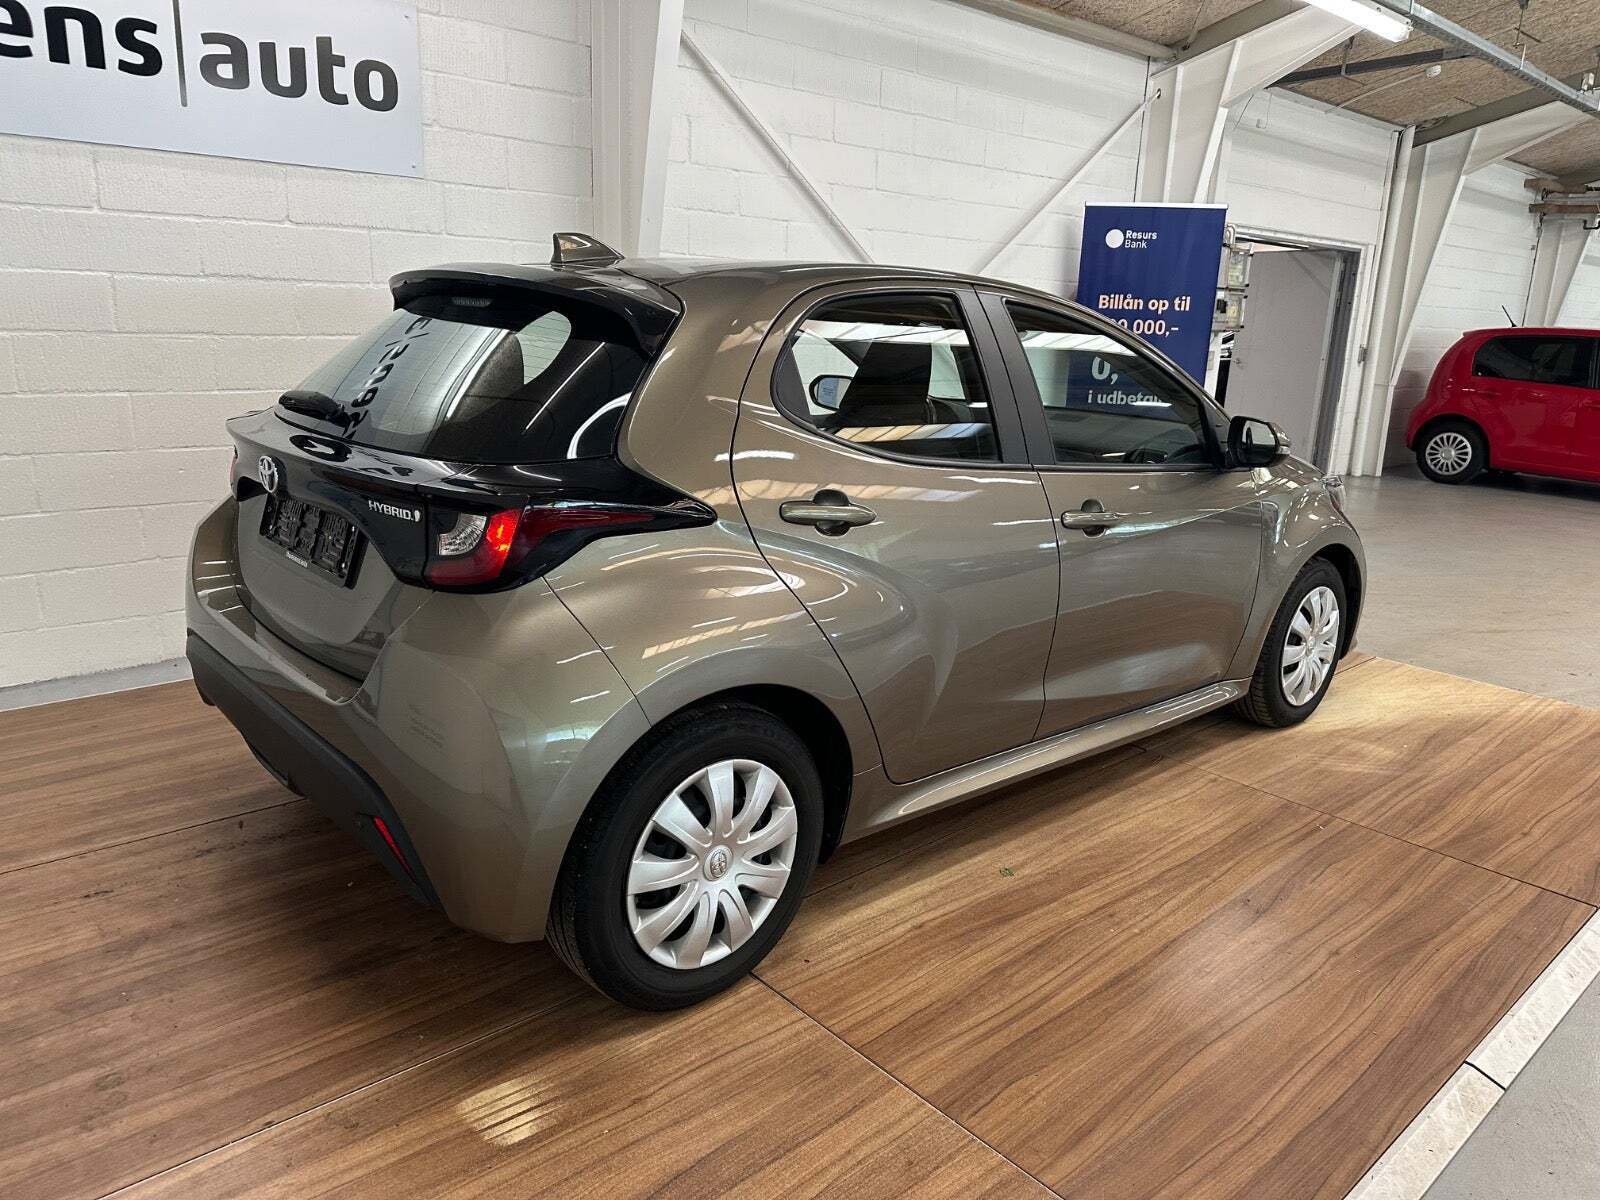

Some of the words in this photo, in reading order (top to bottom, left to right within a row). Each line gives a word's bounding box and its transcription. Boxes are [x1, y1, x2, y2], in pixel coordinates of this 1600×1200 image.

[199, 32, 399, 112] auto
[1126, 230, 1157, 240] Resurs
[1125, 240, 1147, 248] Bank
[1098, 294, 1143, 310] Billån
[1148, 299, 1169, 314] op
[1174, 296, 1191, 311] til
[1087, 390, 1093, 404] i
